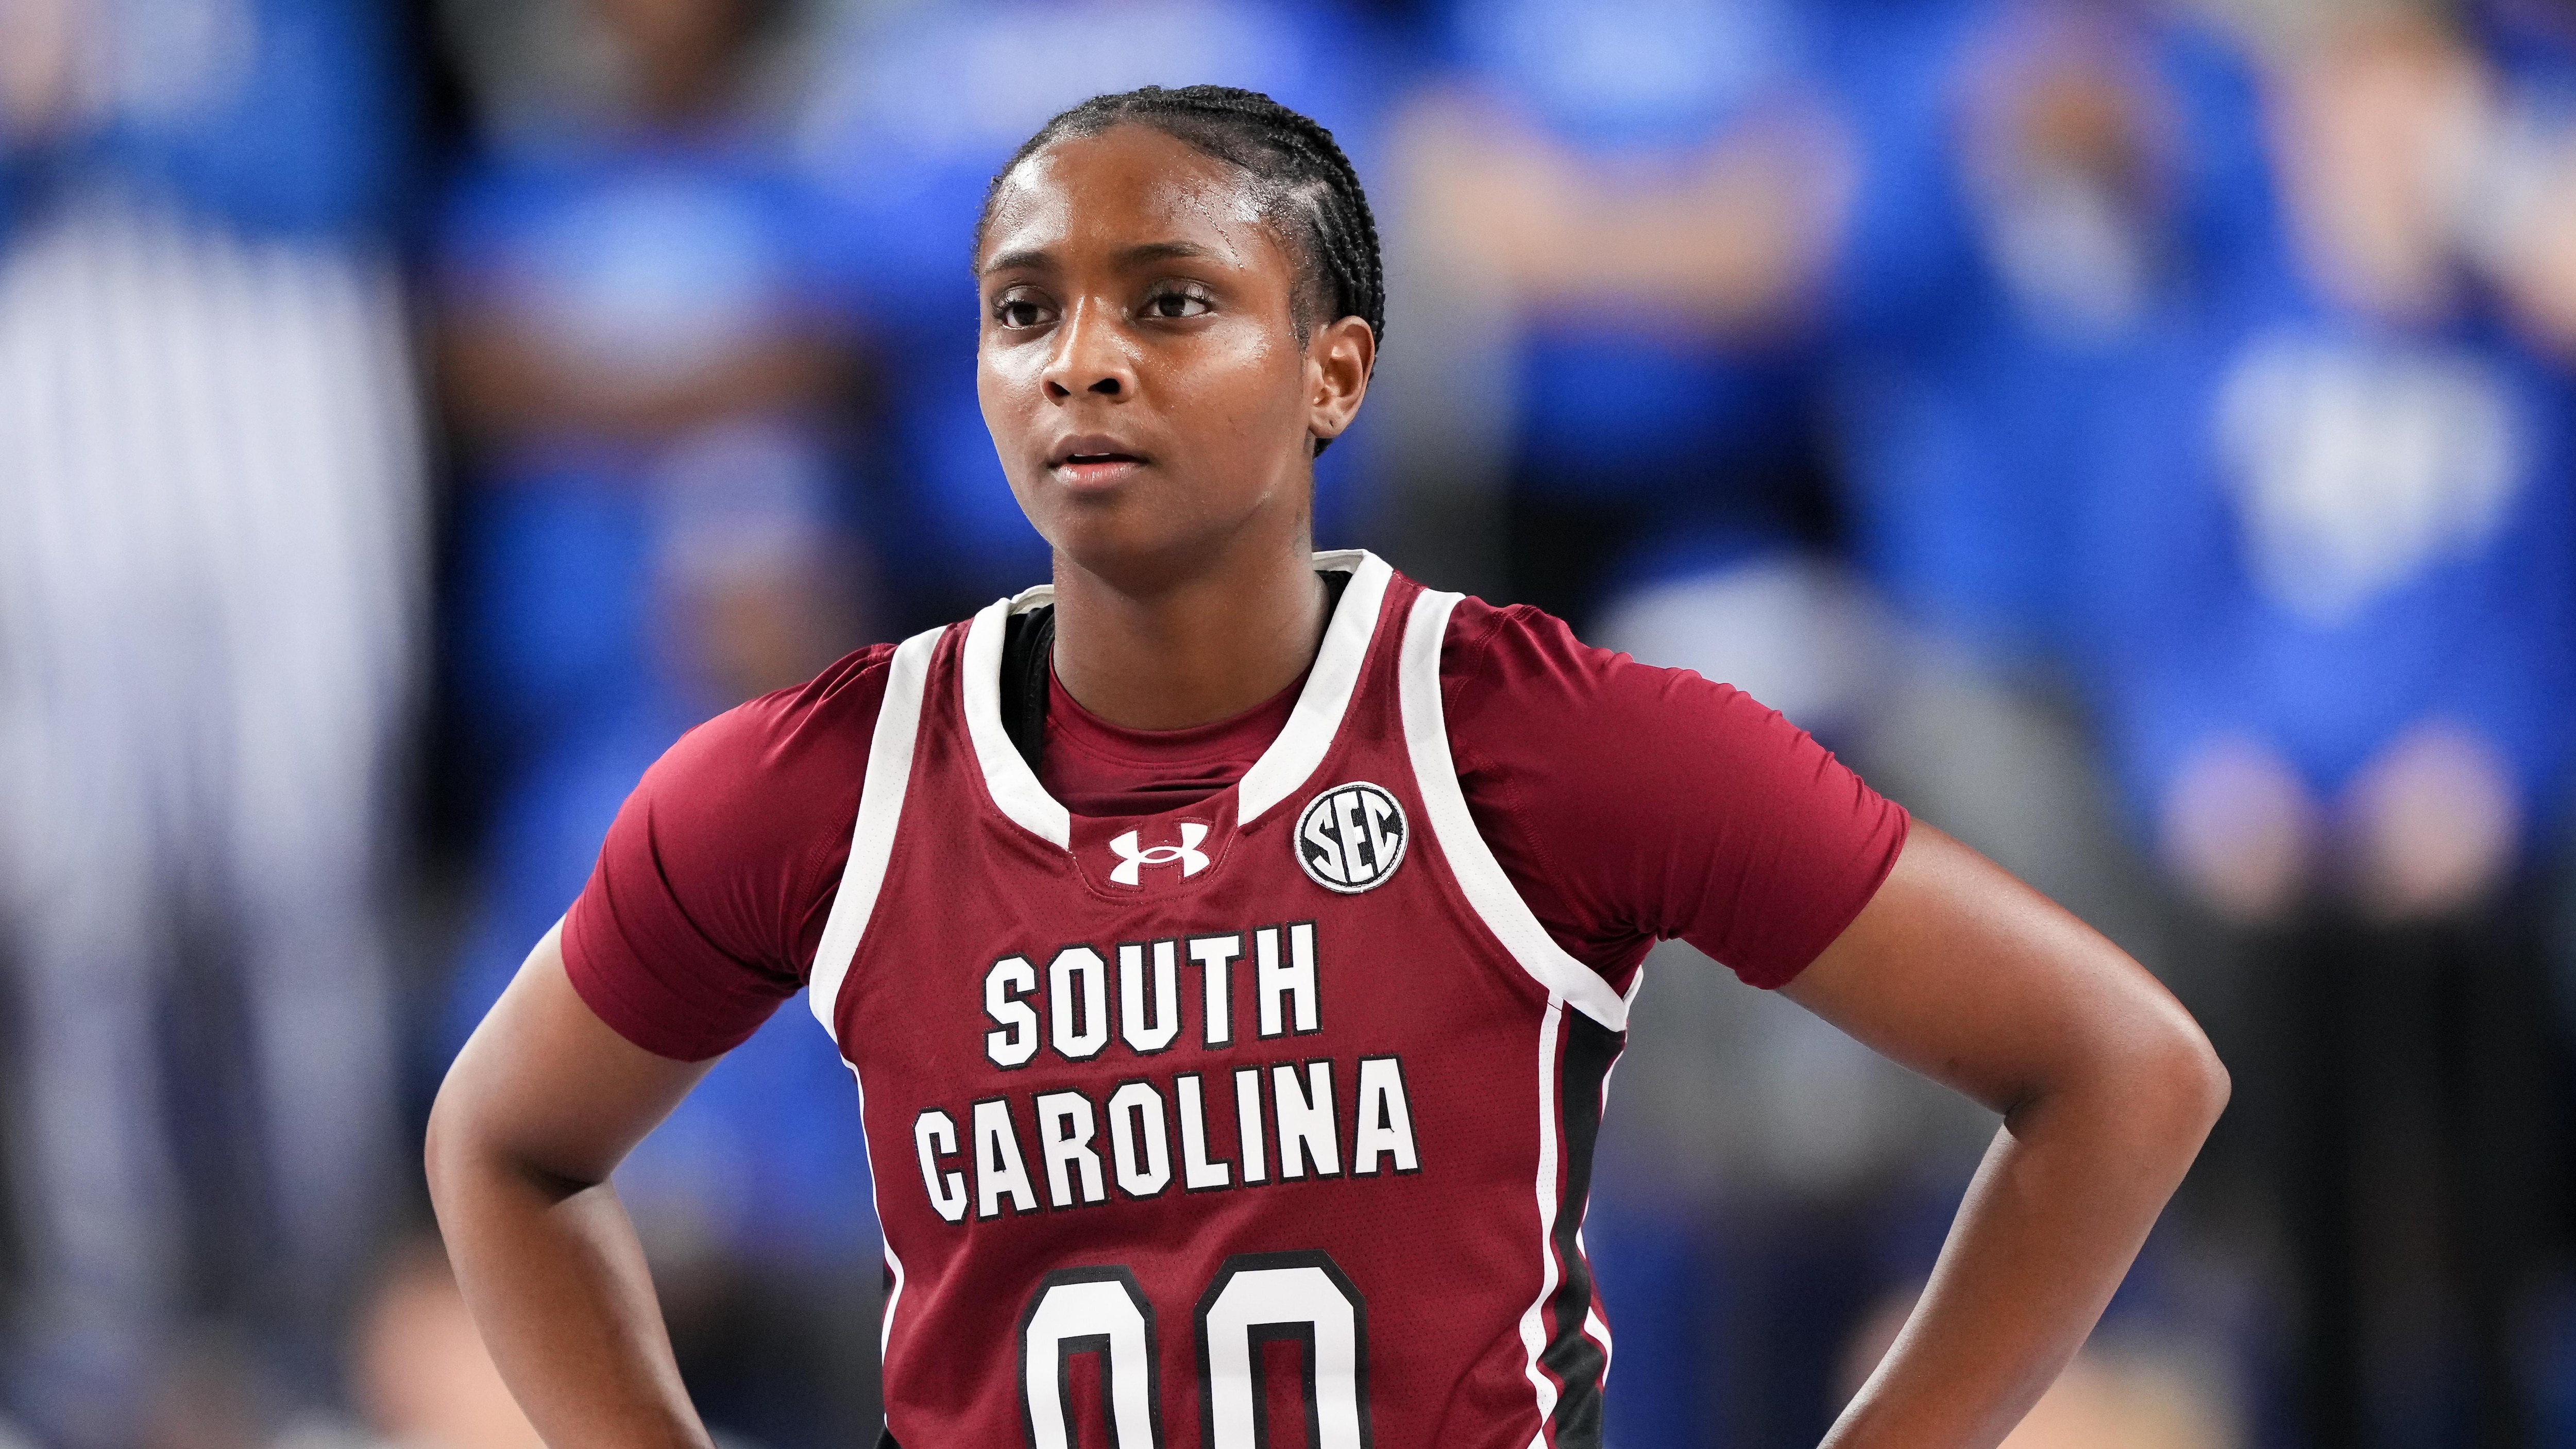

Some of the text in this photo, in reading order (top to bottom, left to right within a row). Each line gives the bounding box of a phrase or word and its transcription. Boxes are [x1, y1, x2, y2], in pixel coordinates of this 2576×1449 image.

[1303, 789, 1399, 884] SEC
[982, 920, 1323, 1070] SOUTH
[912, 1056, 1421, 1224] CAROLINA
